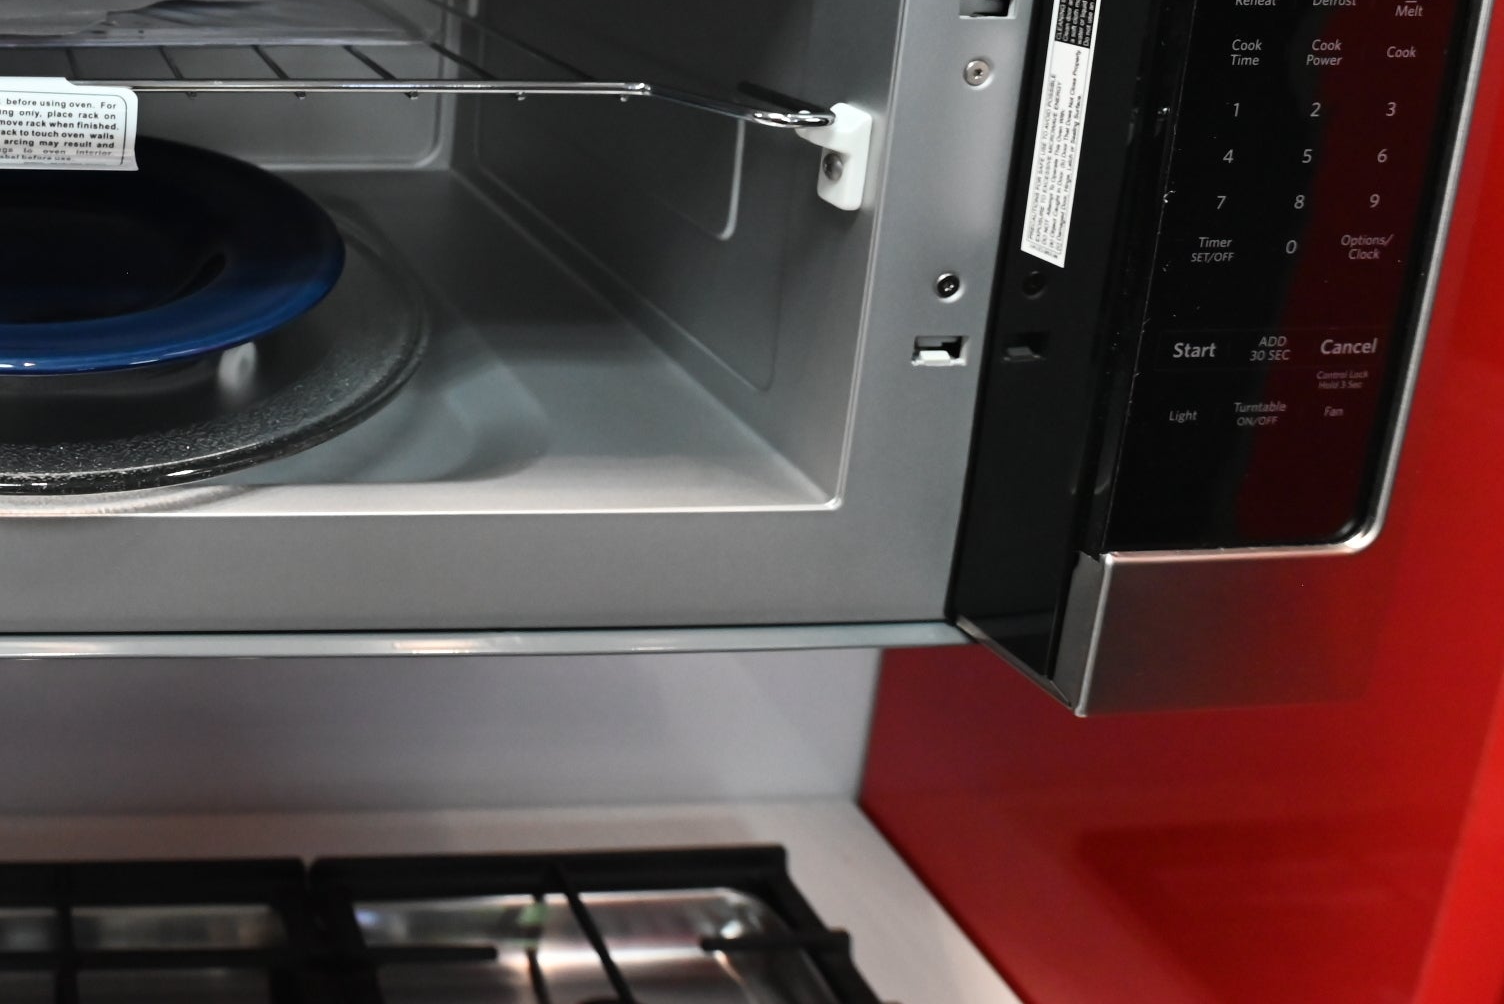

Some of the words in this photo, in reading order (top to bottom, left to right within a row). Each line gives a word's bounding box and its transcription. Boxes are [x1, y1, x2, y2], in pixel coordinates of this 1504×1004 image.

[1396, 6, 1422, 16] Melt
[1232, 39, 1262, 50] Cook
[1312, 39, 1341, 50] Cook
[1387, 46, 1415, 57] Cook
[1231, 54, 1259, 65] Time
[1307, 54, 1342, 65] Power
[7, 98, 37, 106] before
[40, 100, 66, 109] using
[1386, 102, 1396, 116] 3
[1234, 103, 1239, 116] 1
[1310, 102, 1320, 117] 2
[77, 122, 119, 130] finished.
[1223, 150, 1233, 163] 4
[1302, 149, 1312, 163] 5
[1378, 149, 1387, 162] 6
[1217, 196, 1226, 209] 7
[1294, 195, 1304, 209] 8
[1370, 194, 1379, 207] 9
[1199, 237, 1232, 247] Timer
[1341, 235, 1393, 247] Options/
[1191, 253, 1234, 262] SET/OFF
[1349, 249, 1378, 259] Clock
[1259, 336, 1286, 346] ADD
[1321, 338, 1377, 354] Cancel
[1173, 343, 1216, 358] Start
[1250, 351, 1265, 361] 30
[1268, 350, 1290, 360] SEC
[1234, 402, 1286, 412] Turntable
[1324, 406, 1343, 416] Fan
[1169, 411, 1197, 423] Light
[1237, 416, 1277, 426] ON/OFF
